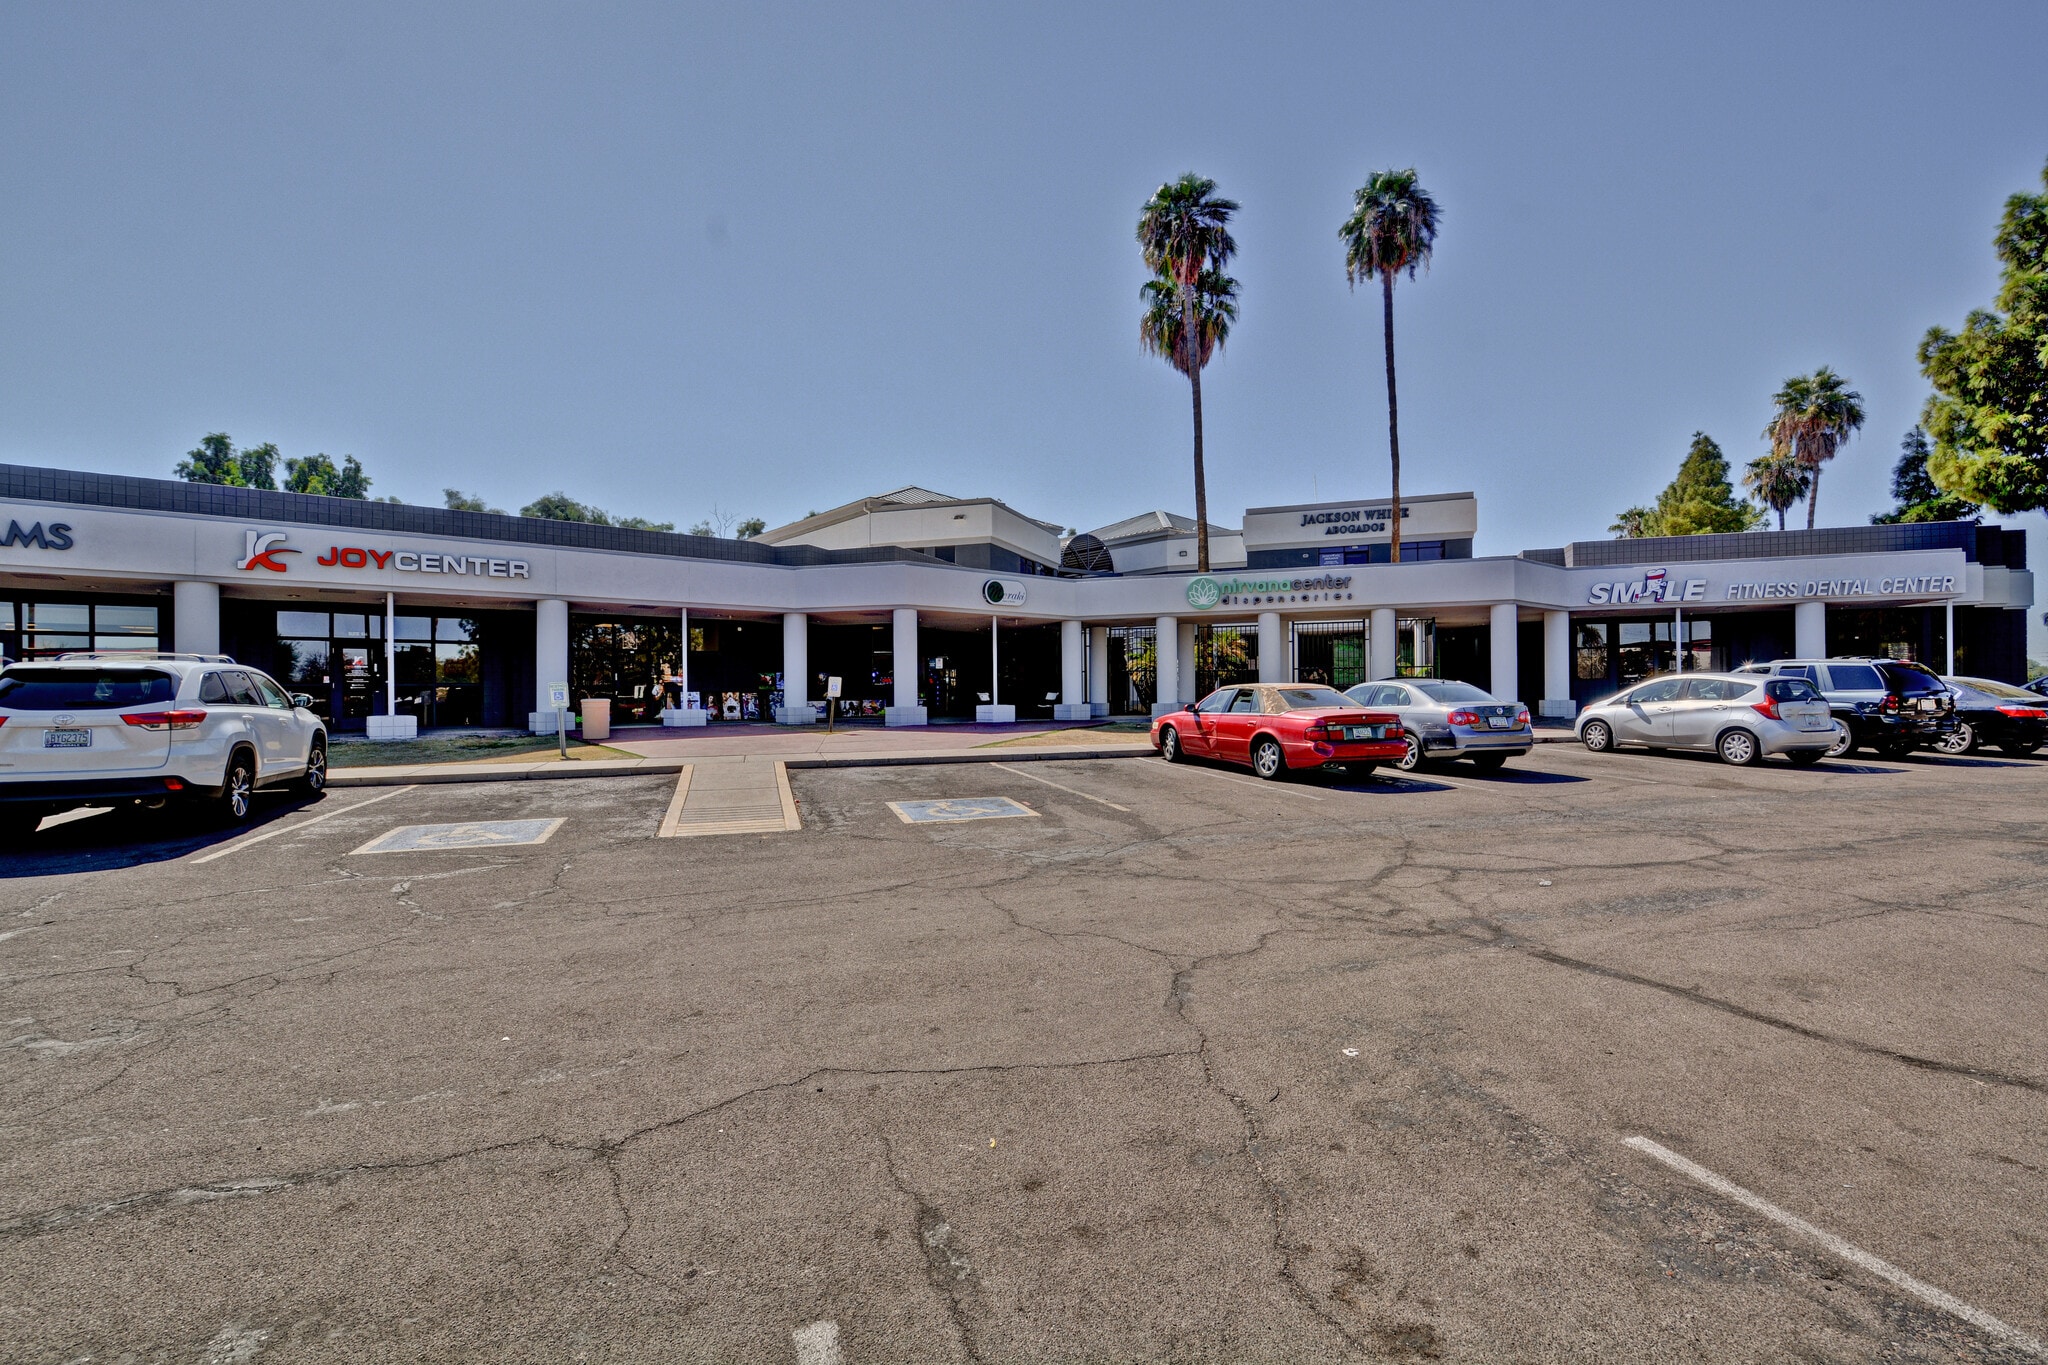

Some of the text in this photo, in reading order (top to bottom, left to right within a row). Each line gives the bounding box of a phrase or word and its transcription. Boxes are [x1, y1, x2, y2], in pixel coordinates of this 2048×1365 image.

[1301, 507, 1410, 527] JACKSON WHIE
[0, 519, 74, 550] MS
[1325, 522, 1386, 535] ABOGADOS
[1726, 575, 1956, 600] FITNESS DENTAL CENTER
[1222, 592, 1353, 606] dispensaries
[50, 733, 88, 743] BYG2375
